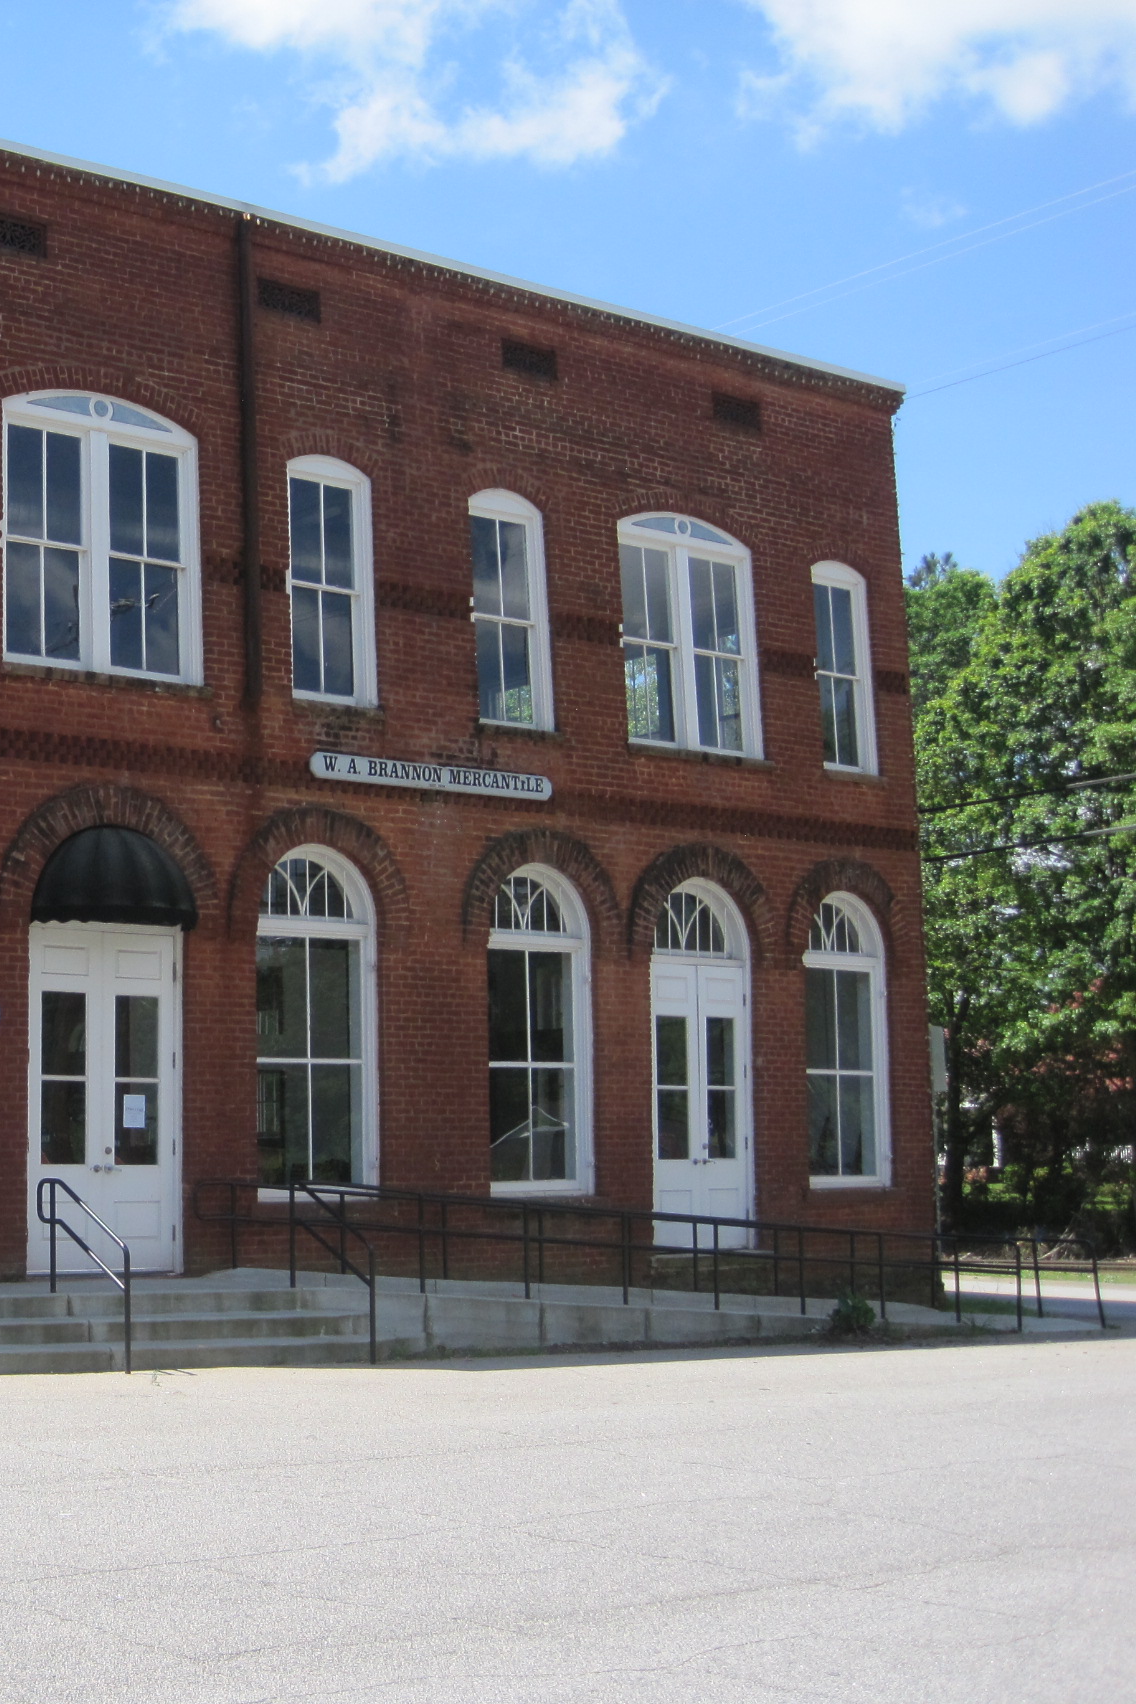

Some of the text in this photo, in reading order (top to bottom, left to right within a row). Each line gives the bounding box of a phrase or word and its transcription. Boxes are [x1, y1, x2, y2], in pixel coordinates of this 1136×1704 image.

[323, 755, 341, 772] W.
[347, 758, 361, 775] A.
[367, 760, 442, 783] BRANNON
